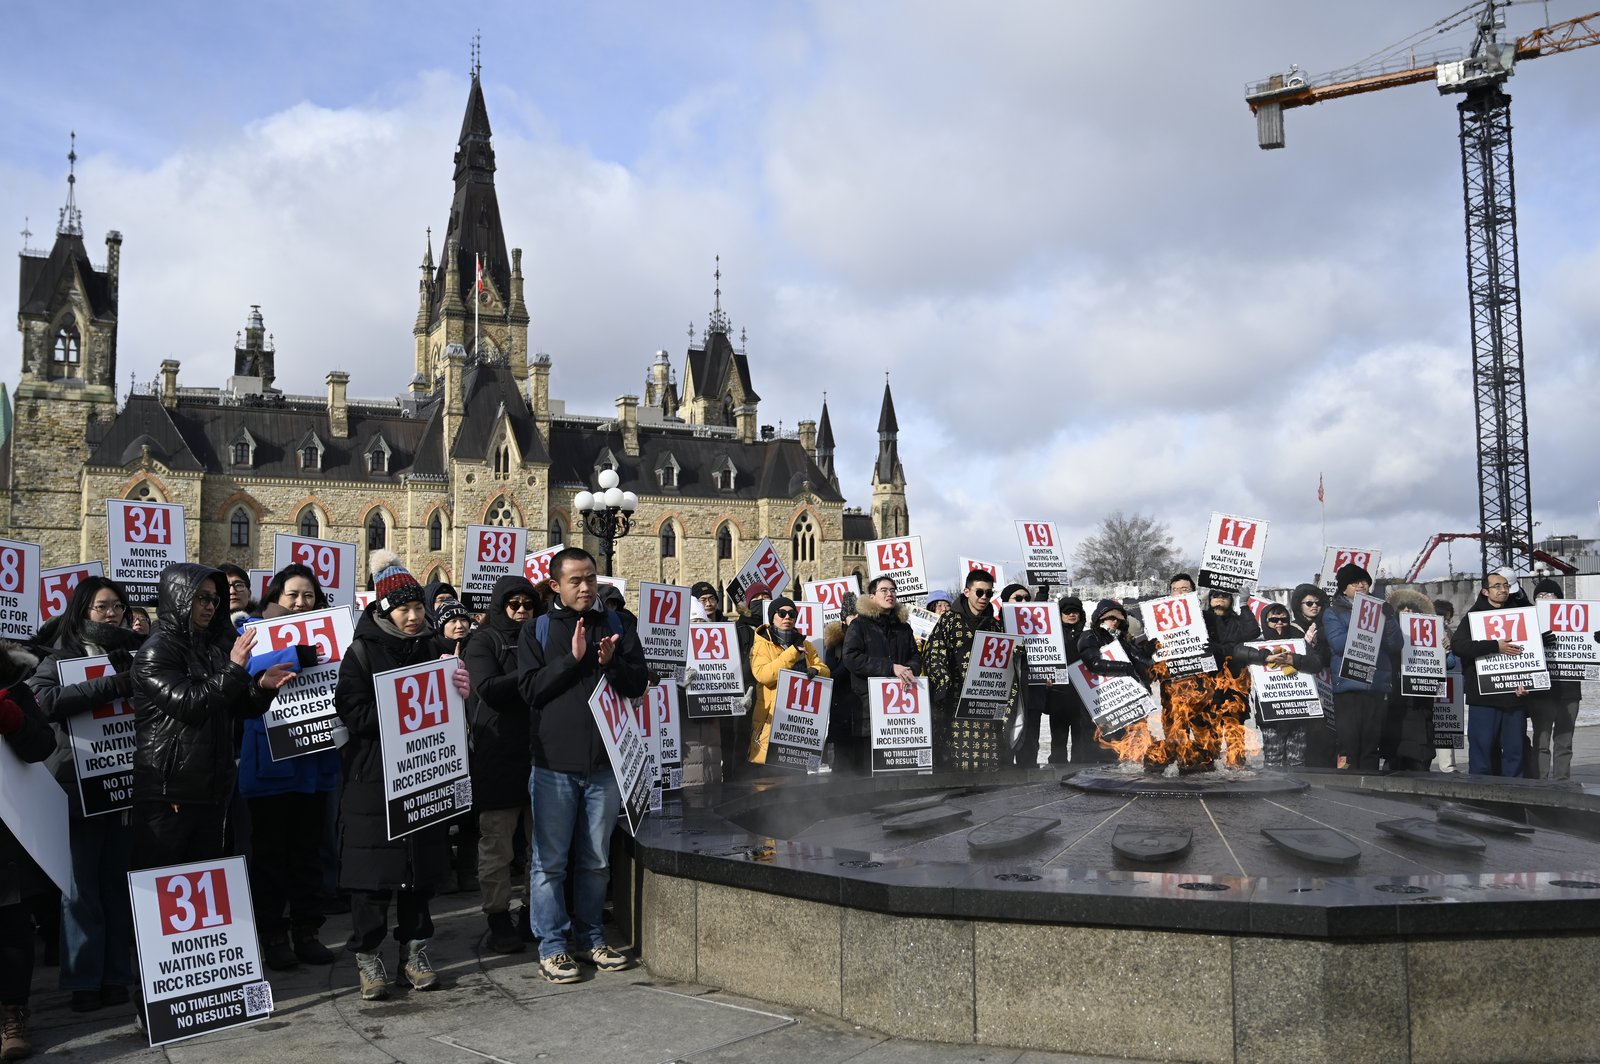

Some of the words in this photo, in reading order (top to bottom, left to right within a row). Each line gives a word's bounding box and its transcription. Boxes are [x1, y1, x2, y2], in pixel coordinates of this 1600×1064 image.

[129, 507, 166, 543] 34
[1029, 524, 1049, 546] 19
[1223, 521, 1251, 547] 17
[130, 548, 167, 558] MONTHS
[482, 533, 511, 562] 38
[882, 543, 908, 569] 43
[121, 559, 157, 568] WAITING
[480, 565, 509, 573] MONTHS
[759, 553, 783, 584] 27
[1220, 565, 1255, 576] RESPONSE
[116, 569, 136, 578] IRCC
[884, 570, 911, 578] MONTHS
[820, 583, 844, 610] 20
[654, 590, 678, 624] 72
[1157, 601, 1187, 629] 30
[10, 610, 27, 622] FOR
[1020, 608, 1047, 633] 33
[1361, 602, 1378, 632] 31
[1554, 605, 1584, 631] 40
[652, 628, 676, 636] MONTHS
[1414, 619, 1433, 646] 13
[1489, 614, 1520, 641] 37
[645, 637, 669, 646] WAITING
[671, 639, 681, 647] FOR
[696, 628, 724, 658] 23
[654, 647, 684, 657] RESPONSE
[984, 638, 1009, 667] 33
[1485, 654, 1517, 662] WAITING
[1408, 658, 1429, 666] WAITING
[1417, 666, 1443, 674] RESPONSE
[1500, 661, 1540, 670] RESPONSE
[287, 669, 337, 690] MONTHS
[722, 672, 735, 680] FOR
[979, 671, 1002, 679] MONTHS
[1269, 674, 1298, 682] MONTHS
[706, 682, 739, 690] RESPONSE
[966, 688, 980, 696] IRCC
[979, 689, 1007, 697] RESPONSE
[1096, 679, 1124, 695] MONTHS
[1264, 682, 1293, 690] WAITING
[1279, 689, 1313, 697] RESPONSE
[277, 686, 328, 705] WAITING
[402, 671, 443, 731] 34
[791, 679, 814, 712] 11
[886, 683, 915, 713] 25
[1093, 688, 1120, 705] WAITING
[1094, 704, 1109, 714] IRCC
[1109, 688, 1141, 707] RESPONSE
[272, 705, 300, 721] IRCC
[787, 715, 813, 725] MONTHS
[288, 723, 303, 737] NO
[780, 723, 805, 734] WAITING
[807, 727, 818, 736] FOR
[295, 733, 310, 747] NO
[406, 732, 445, 754] MONTHS
[663, 739, 674, 747] FOR
[774, 732, 788, 740] IRCC
[788, 735, 820, 746] RESPONSE
[893, 736, 927, 744] RESPONSE
[85, 755, 115, 771] IRCC
[397, 751, 436, 773] WAITING
[439, 745, 456, 761] FOR
[103, 778, 118, 789] NO
[393, 774, 414, 792] IRCC
[415, 759, 462, 785] RESPONSE
[110, 789, 125, 801] NO
[404, 798, 415, 811] NO
[416, 784, 454, 806] TIMELINES
[408, 810, 419, 823] NO
[420, 798, 452, 819] RESULTS
[167, 871, 224, 932] 31
[172, 932, 228, 954] MONTHS
[159, 952, 216, 975] WAITING
[219, 947, 244, 963] FOR
[153, 976, 184, 994] IRCC
[185, 962, 254, 987] RESPONSE
[170, 1002, 186, 1015] NO
[188, 989, 244, 1011] TIMELINES
[177, 1015, 194, 1028] NO
[196, 1004, 242, 1025] RESULTS
